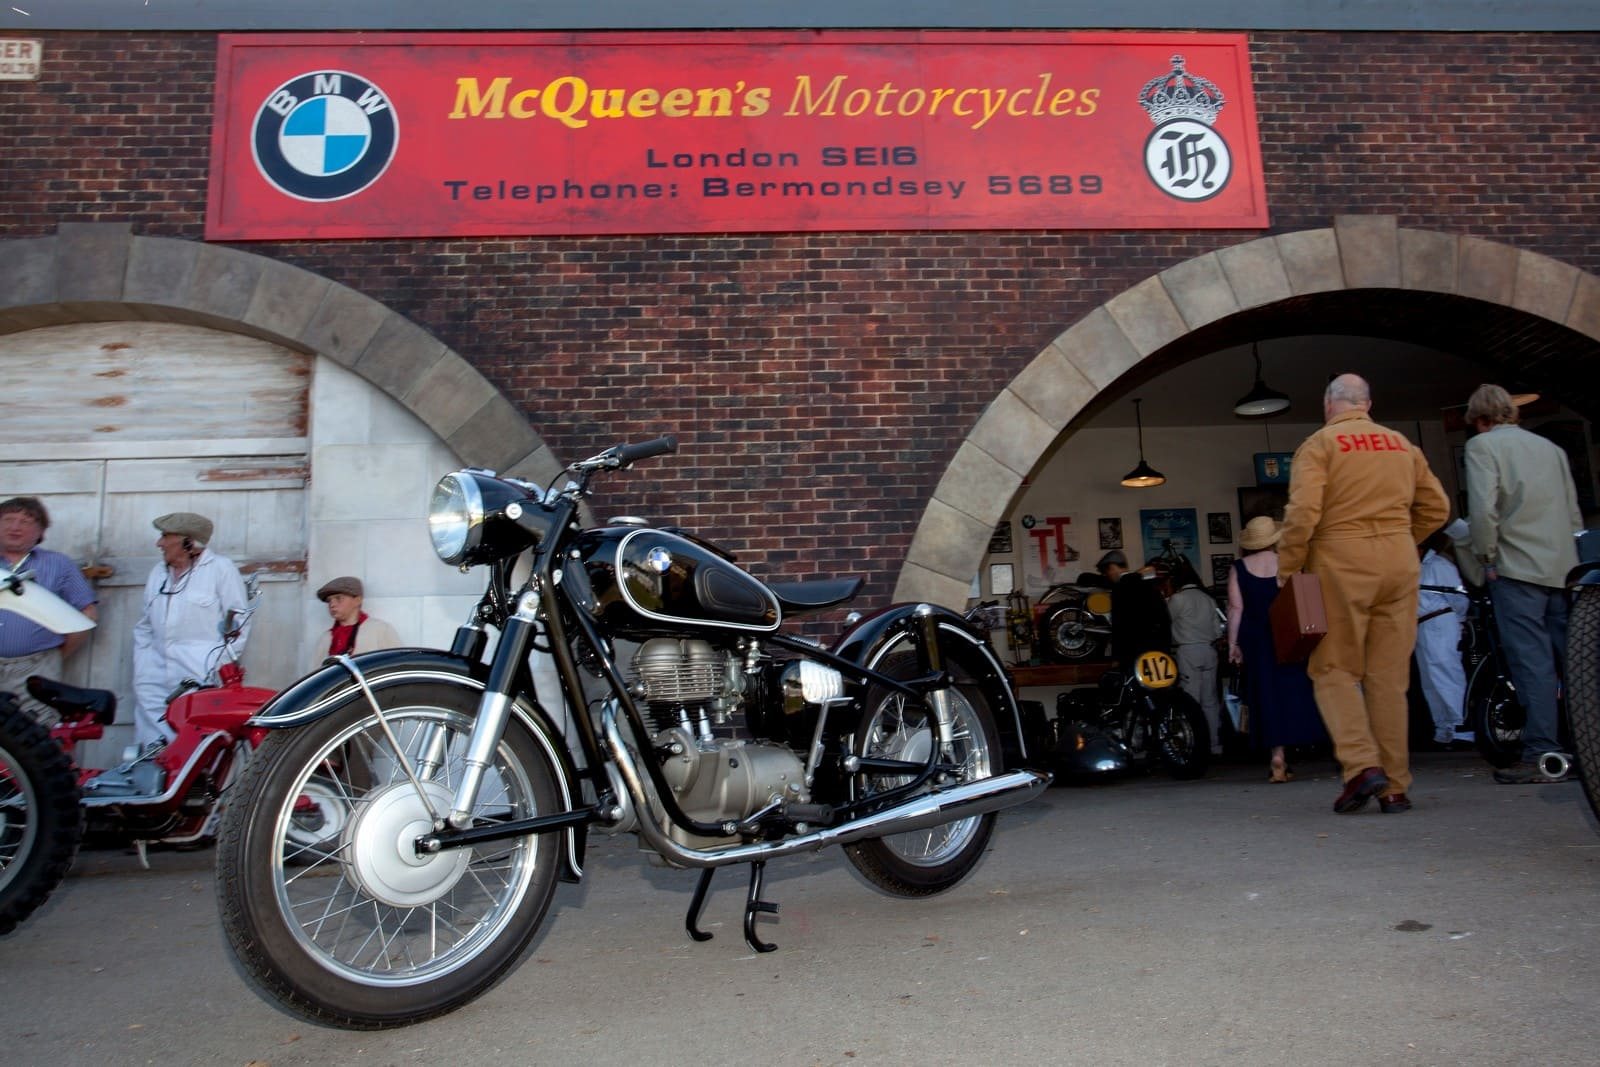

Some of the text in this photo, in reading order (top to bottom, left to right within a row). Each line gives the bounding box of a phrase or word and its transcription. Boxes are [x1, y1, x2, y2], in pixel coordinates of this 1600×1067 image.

[268, 74, 388, 116] BMW
[448, 73, 1100, 130] McQueen's Motorcycles
[646, 146, 918, 168] London SE16
[444, 174, 1103, 204] Telephone: Bermondsey 5689
[1336, 432, 1409, 453] SHELL
[1142, 655, 1175, 682] 412
